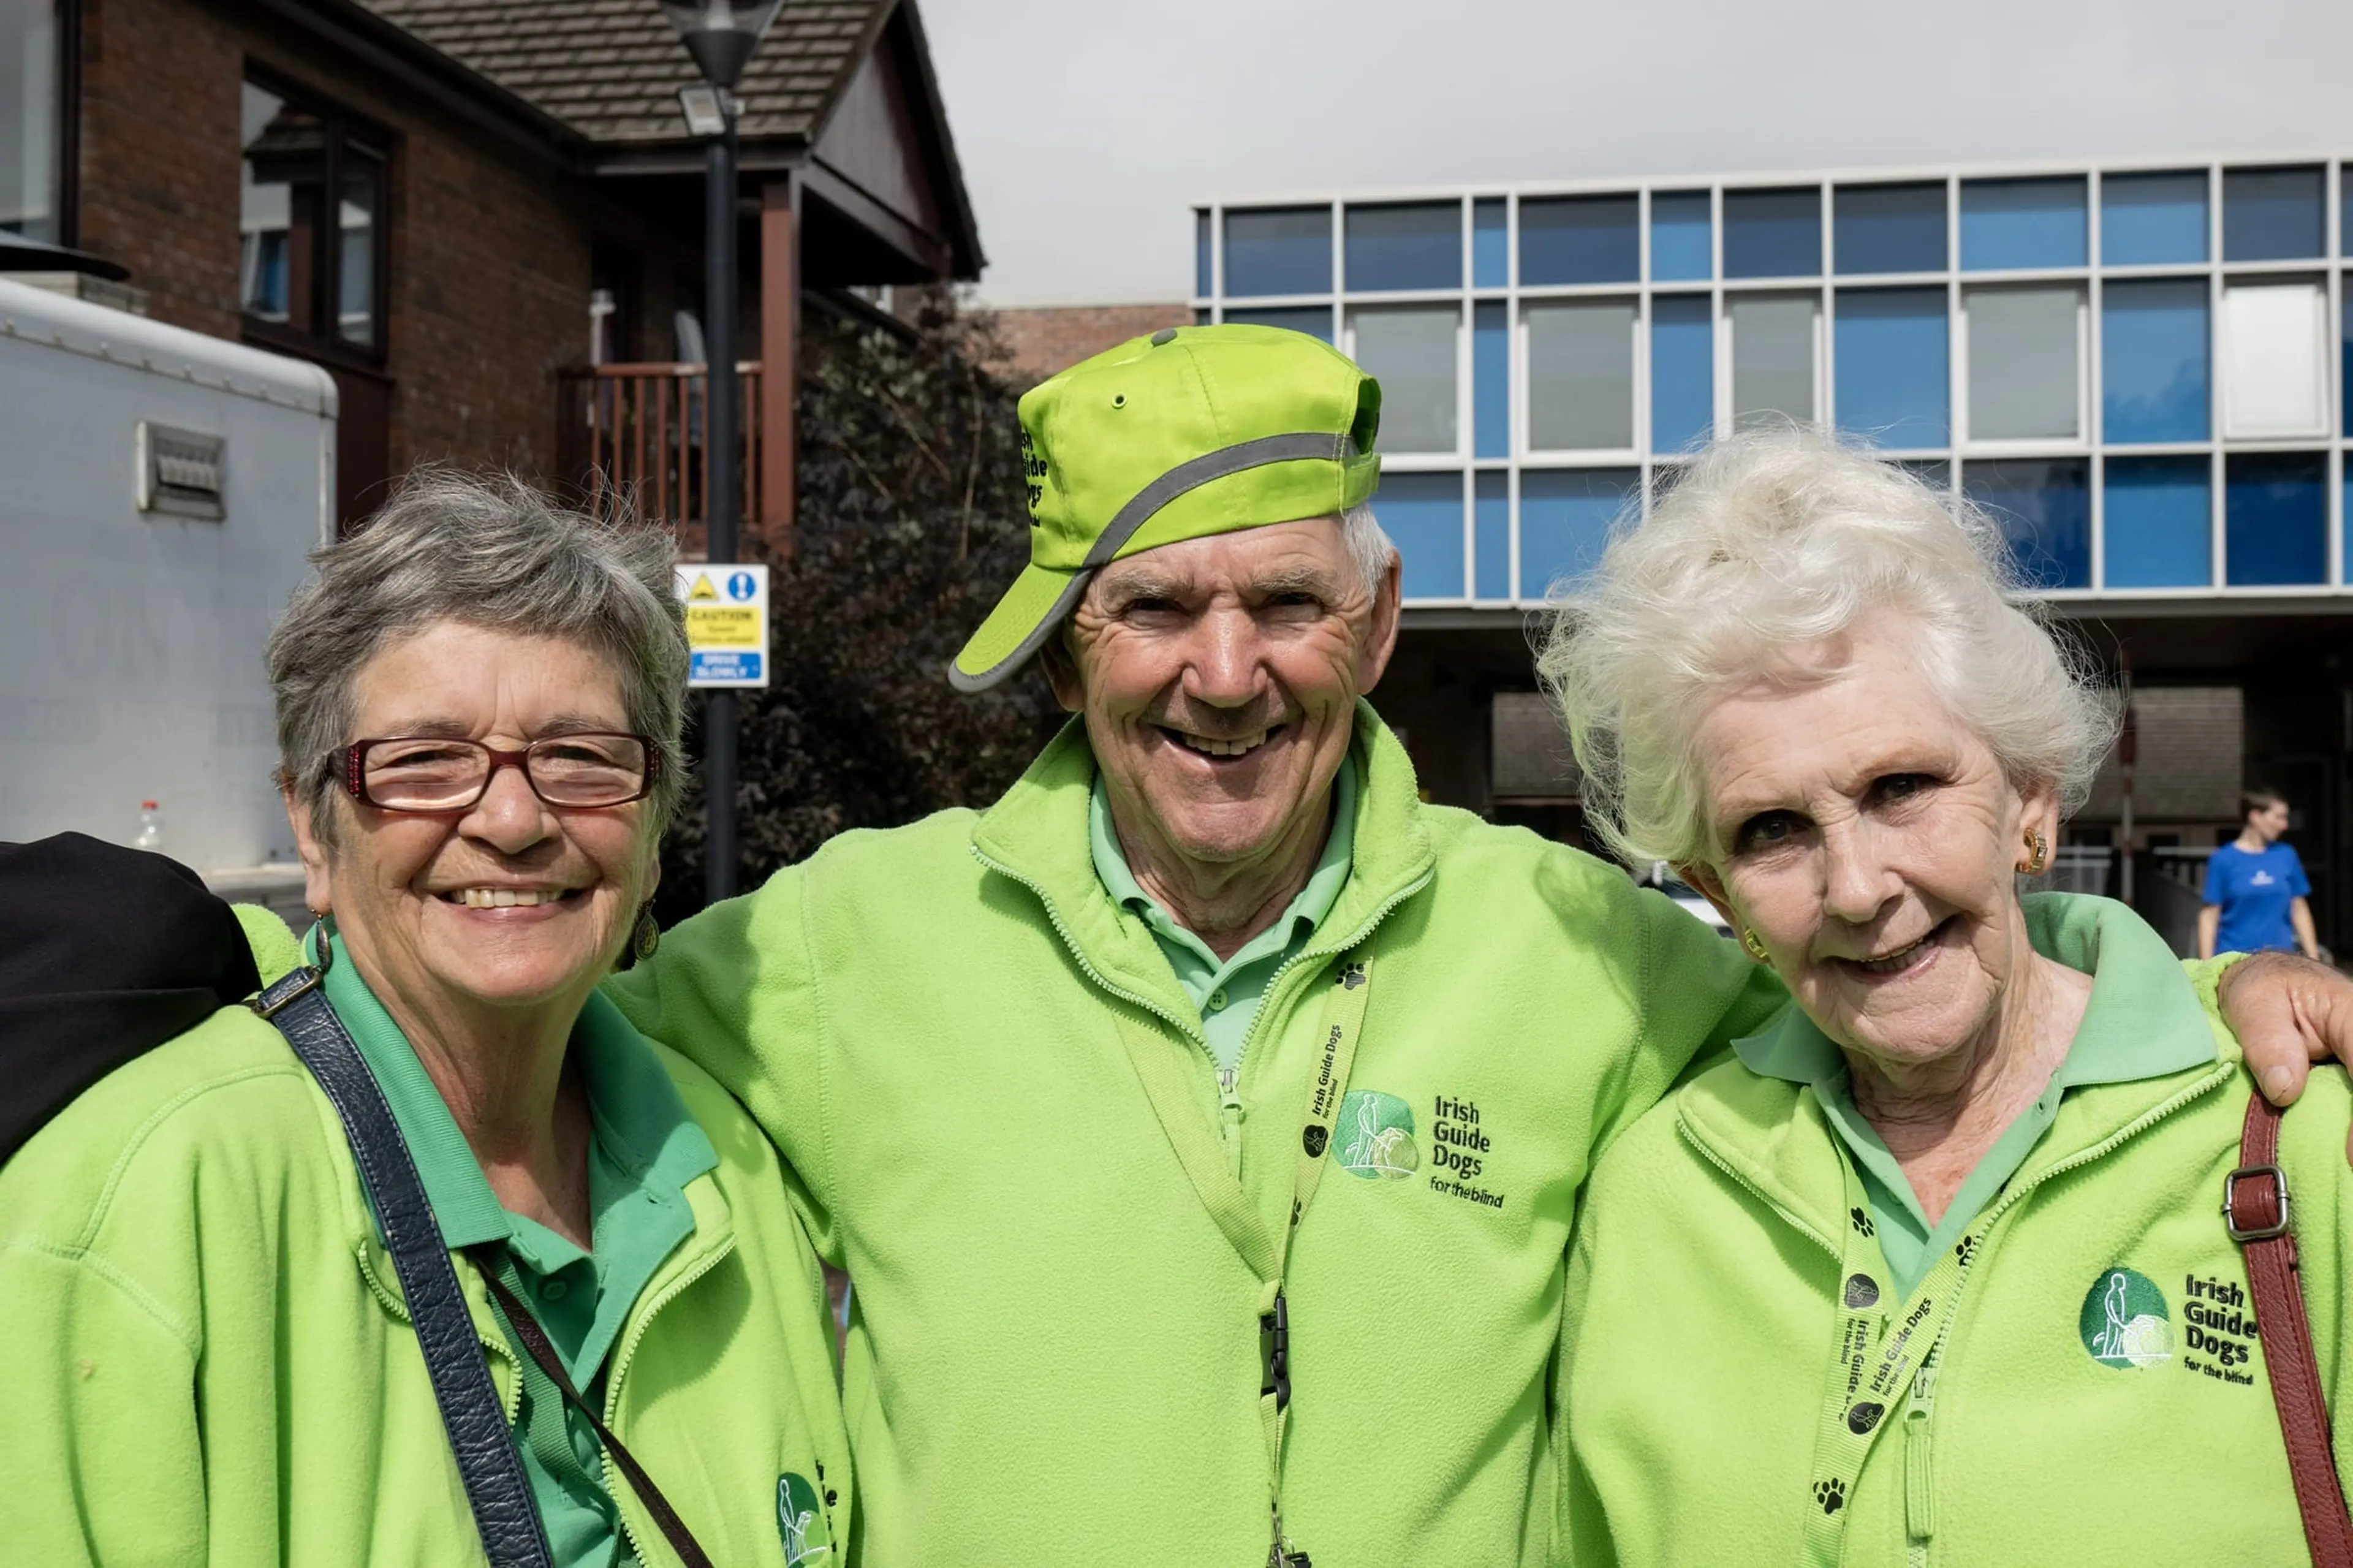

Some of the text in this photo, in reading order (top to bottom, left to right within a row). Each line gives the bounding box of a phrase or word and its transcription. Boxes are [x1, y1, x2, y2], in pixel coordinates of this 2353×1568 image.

[1024, 453, 1048, 477] ide
[1312, 1024, 1343, 1116] Irish Guide Dogs
[1328, 1078, 1338, 1097] blind
[1435, 1095, 1479, 1124] Irish
[1433, 1120, 1490, 1153] Guide
[1433, 1144, 1482, 1180] Dogs
[2186, 1274, 2244, 1308] Irish
[2184, 1301, 2258, 1339] Guide
[1847, 1320, 1869, 1393] Irish Guide
[1869, 1297, 1931, 1392] Irish Guide Dogs
[2185, 1324, 2249, 1366] Dogs
[2184, 1356, 2254, 1385] for the blind
